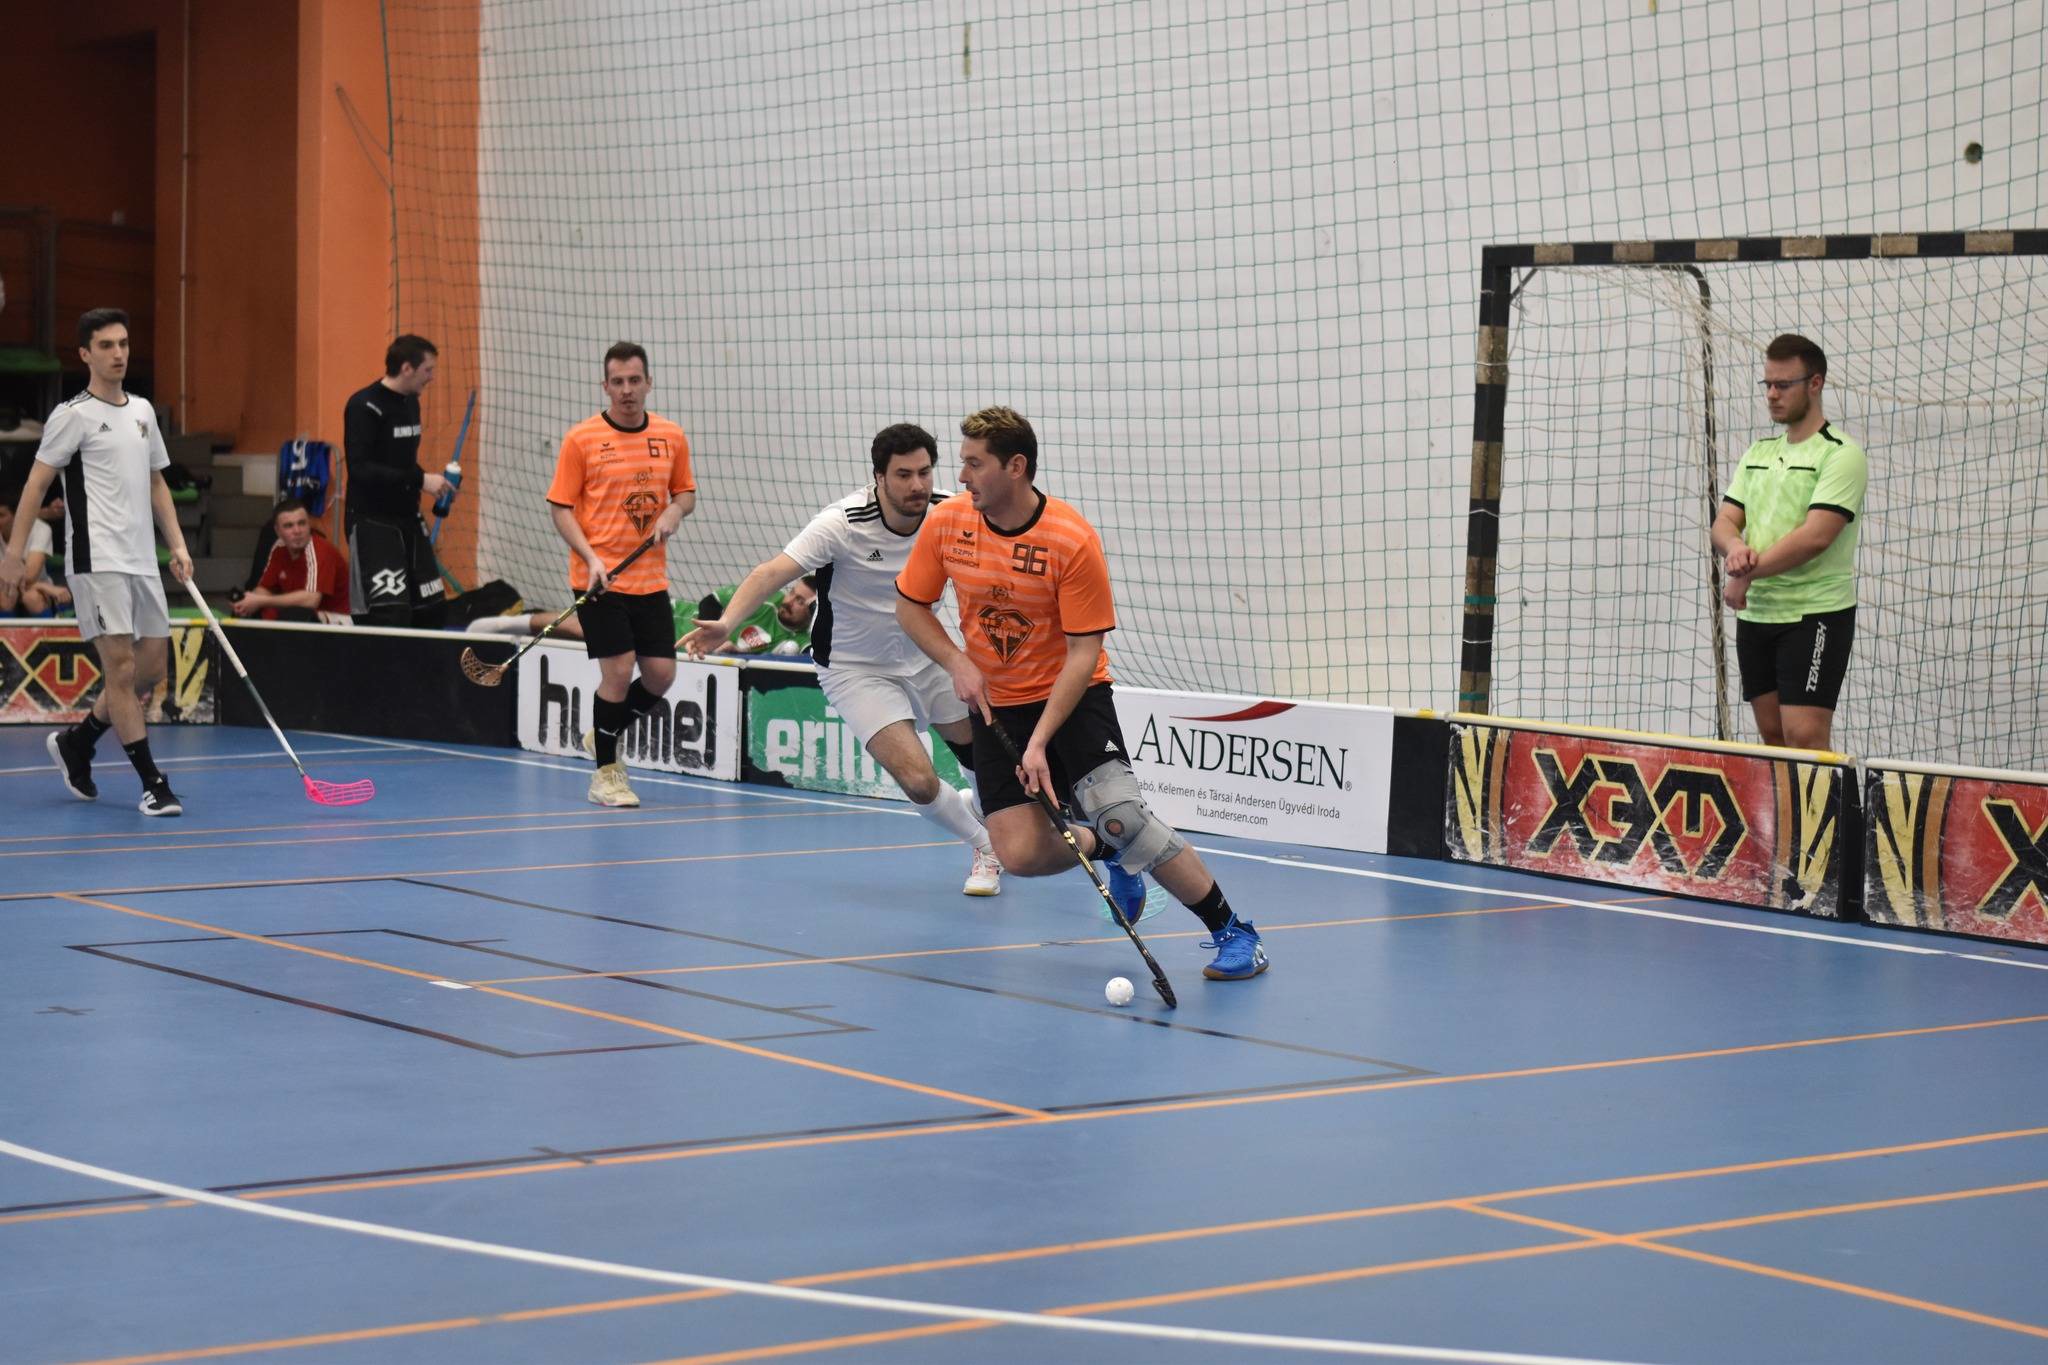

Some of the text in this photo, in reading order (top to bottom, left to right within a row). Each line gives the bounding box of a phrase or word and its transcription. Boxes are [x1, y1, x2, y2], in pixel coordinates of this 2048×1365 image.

[1011, 542, 1049, 577] 96
[1805, 621, 1828, 693] TEMPISH
[538, 654, 718, 771] humel
[1158, 782, 1196, 798] Kelemen
[1197, 787, 1207, 800] és
[1209, 788, 1233, 804] Társai
[1235, 793, 1276, 809] Andersen
[1279, 797, 1316, 815] Ügyvédi
[1317, 804, 1340, 819] Iroda
[1196, 805, 1268, 826] hu.andersen.com
